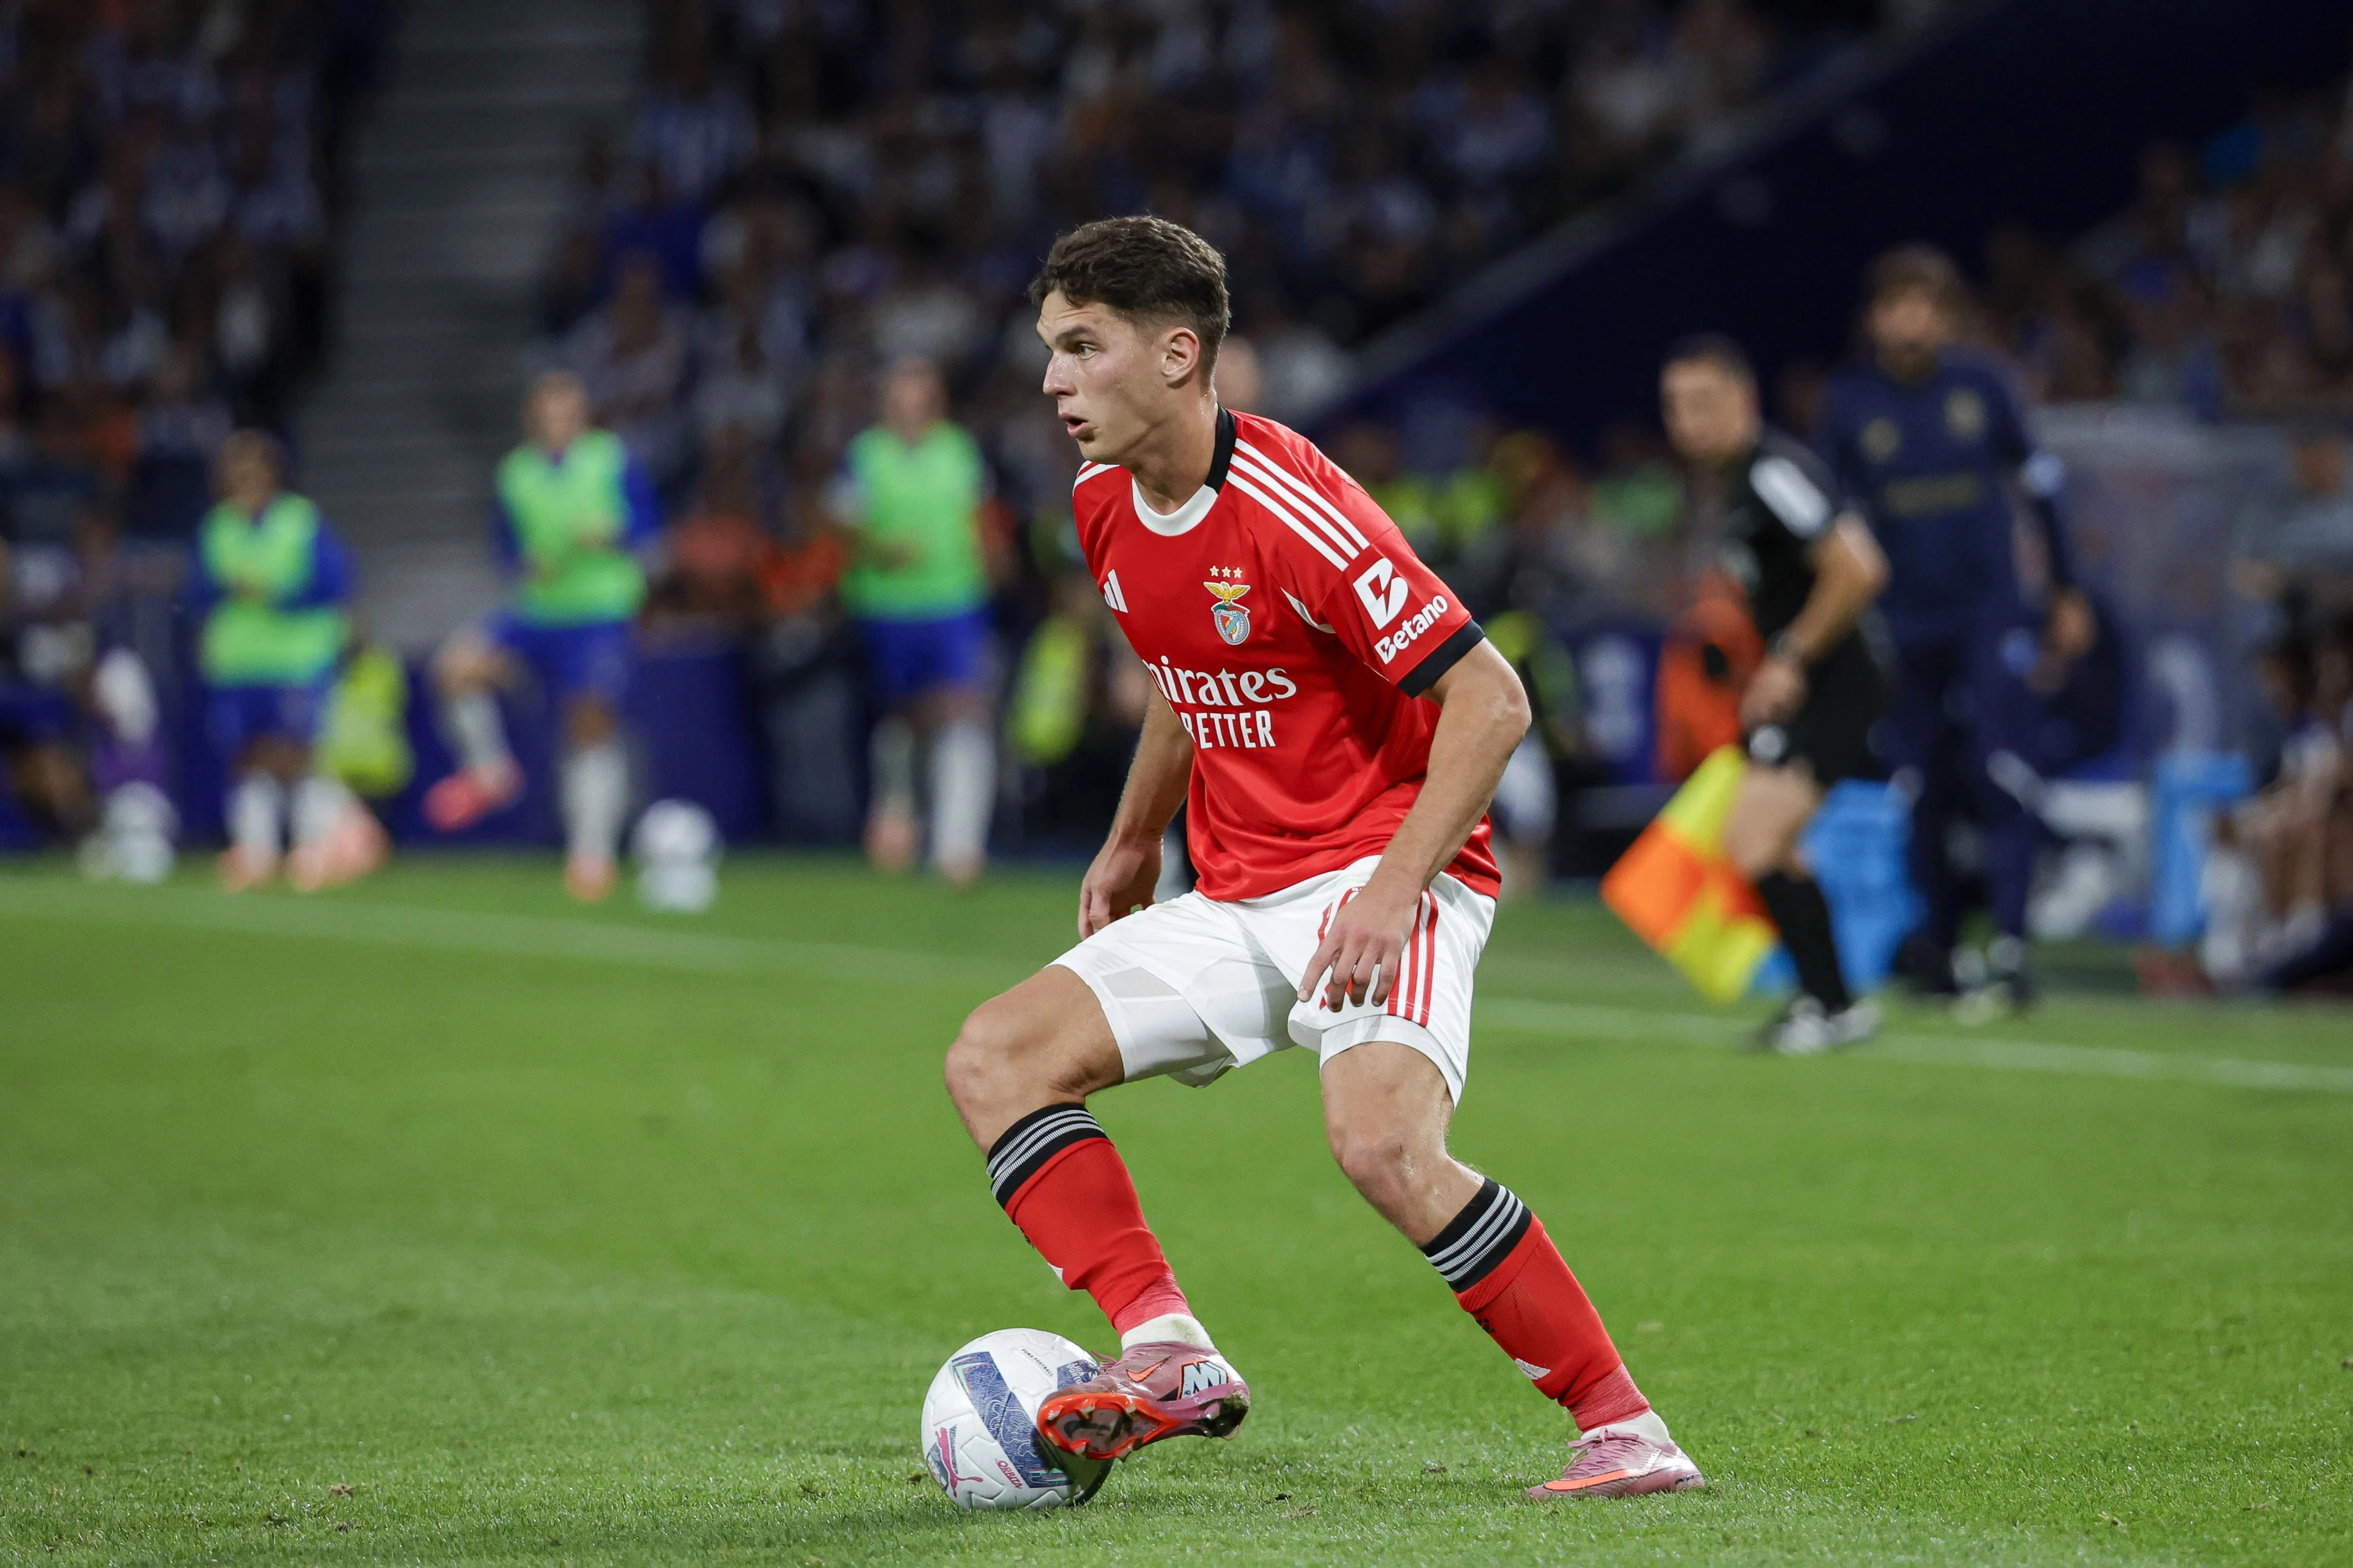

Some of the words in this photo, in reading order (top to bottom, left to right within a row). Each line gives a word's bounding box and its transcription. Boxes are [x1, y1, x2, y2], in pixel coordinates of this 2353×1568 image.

[1374, 595, 1448, 665] Betano
[1142, 655, 1297, 706] irates
[1034, 1358, 1053, 1377] FOOTBALL
[1066, 1365, 1083, 1384] PORTU
[997, 1460, 1023, 1489] ORBITA
